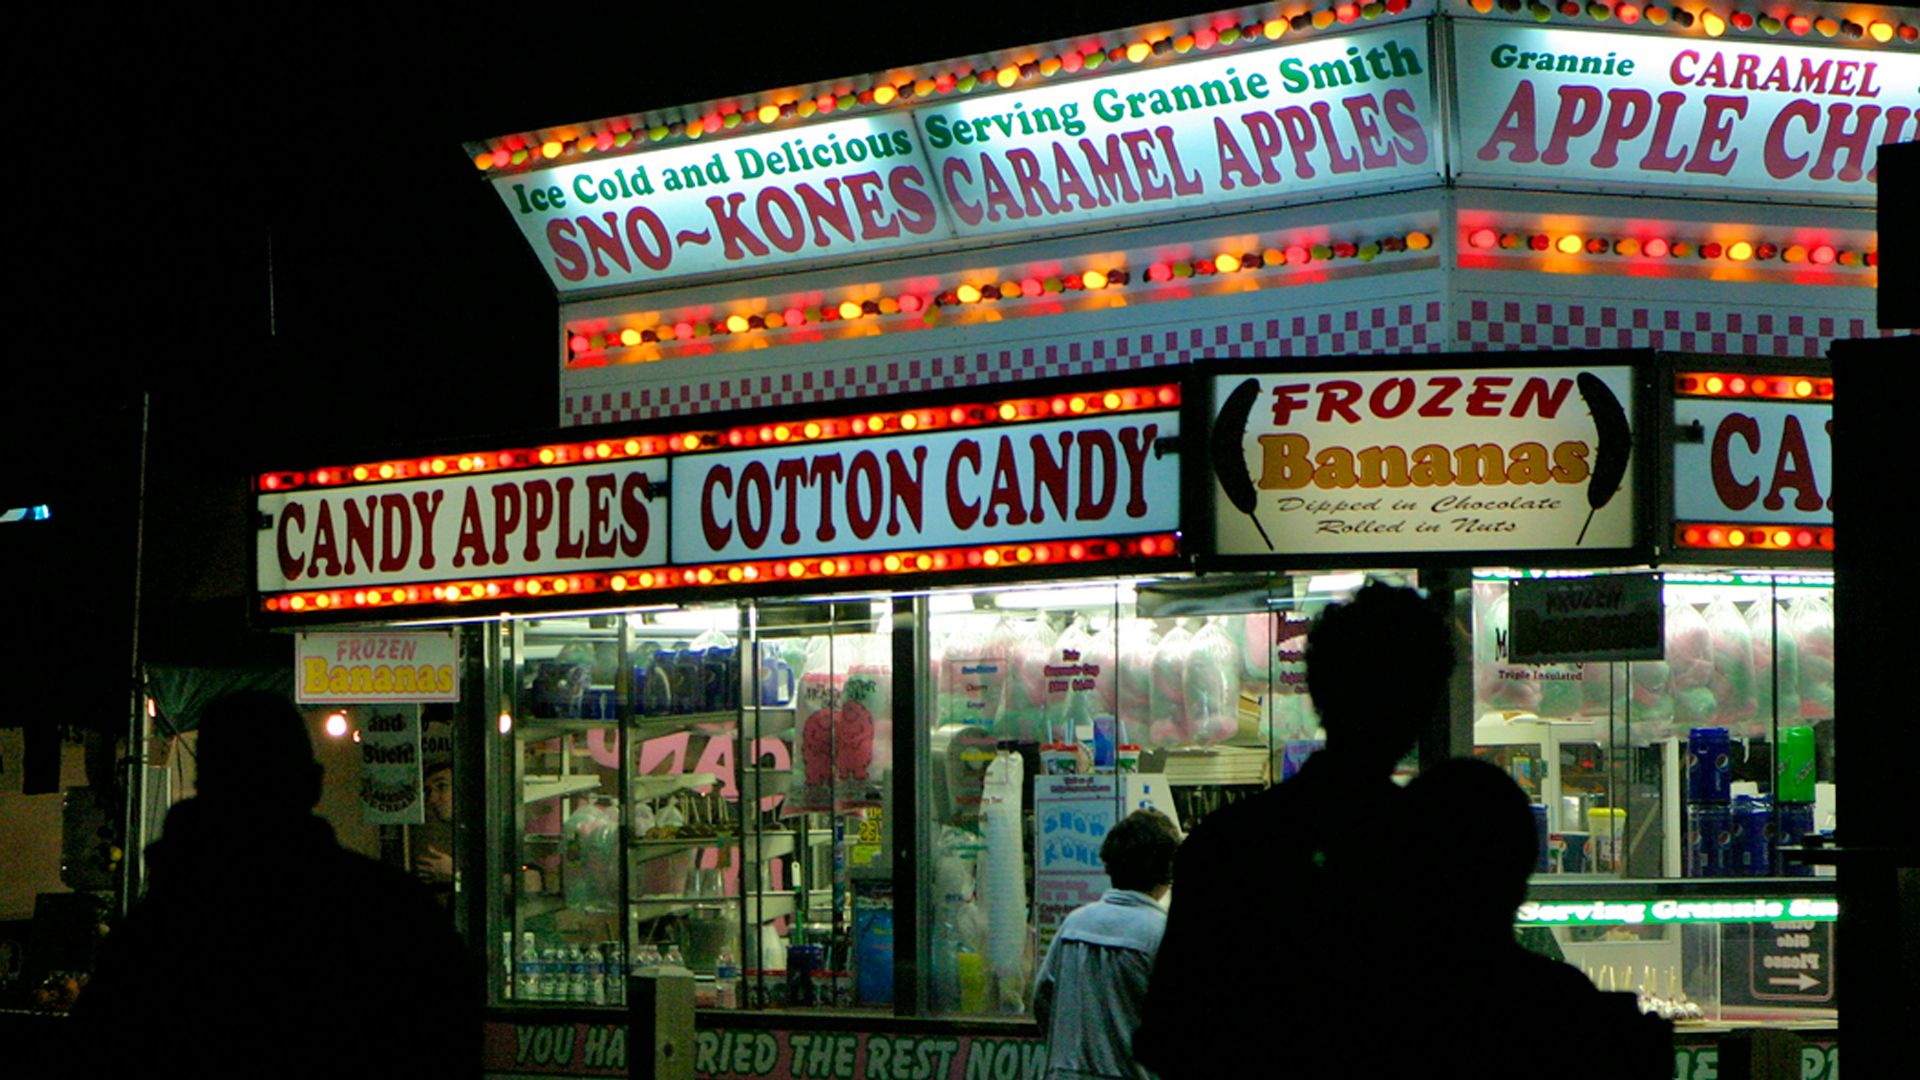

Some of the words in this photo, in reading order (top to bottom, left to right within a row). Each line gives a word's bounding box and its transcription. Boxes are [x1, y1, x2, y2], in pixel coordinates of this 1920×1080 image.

[1490, 43, 1635, 78] Grannie
[1669, 49, 1881, 98] CARAMEL
[925, 100, 1087, 149] Serving
[1093, 66, 1269, 123] Grannie
[1280, 39, 1424, 94] Smith
[1476, 79, 1748, 176] APPLE
[1763, 98, 1920, 183] CHI
[512, 182, 564, 214] Ice
[573, 164, 655, 204] Cold
[664, 153, 731, 191] and
[735, 127, 912, 180] Delicious
[942, 125, 1204, 227] CARAMEL
[1213, 88, 1429, 191] APPLES
[1270, 376, 1575, 426] FROZEN
[1257, 432, 1591, 491] Bananas
[1711, 411, 1833, 512] CA
[700, 445, 928, 551] COTTON
[945, 423, 1158, 531] CANDY
[1276, 496, 1383, 514] Dipped
[1391, 499, 1417, 511] in
[1429, 495, 1562, 513] Chocolate
[277, 489, 444, 581] CANDY
[452, 471, 651, 567] APPLES
[1315, 519, 1406, 535] Rolled
[1414, 520, 1442, 533] in
[1450, 517, 1518, 534] Nuts
[336, 638, 417, 662] FROZEN
[302, 655, 454, 696] Bananas
[1498, 669, 1531, 681] Triple
[1533, 670, 1583, 681] Insulated
[367, 712, 406, 732] and
[1043, 836, 1103, 868] KONE
[1517, 901, 1647, 923] Serving
[1651, 899, 1784, 919] Grannie
[1789, 899, 1838, 917] Sm
[515, 1025, 576, 1066] YOU
[584, 1026, 628, 1068] HA
[695, 1030, 778, 1076] RIED
[789, 1034, 857, 1079] THE
[866, 1035, 958, 1080] REST
